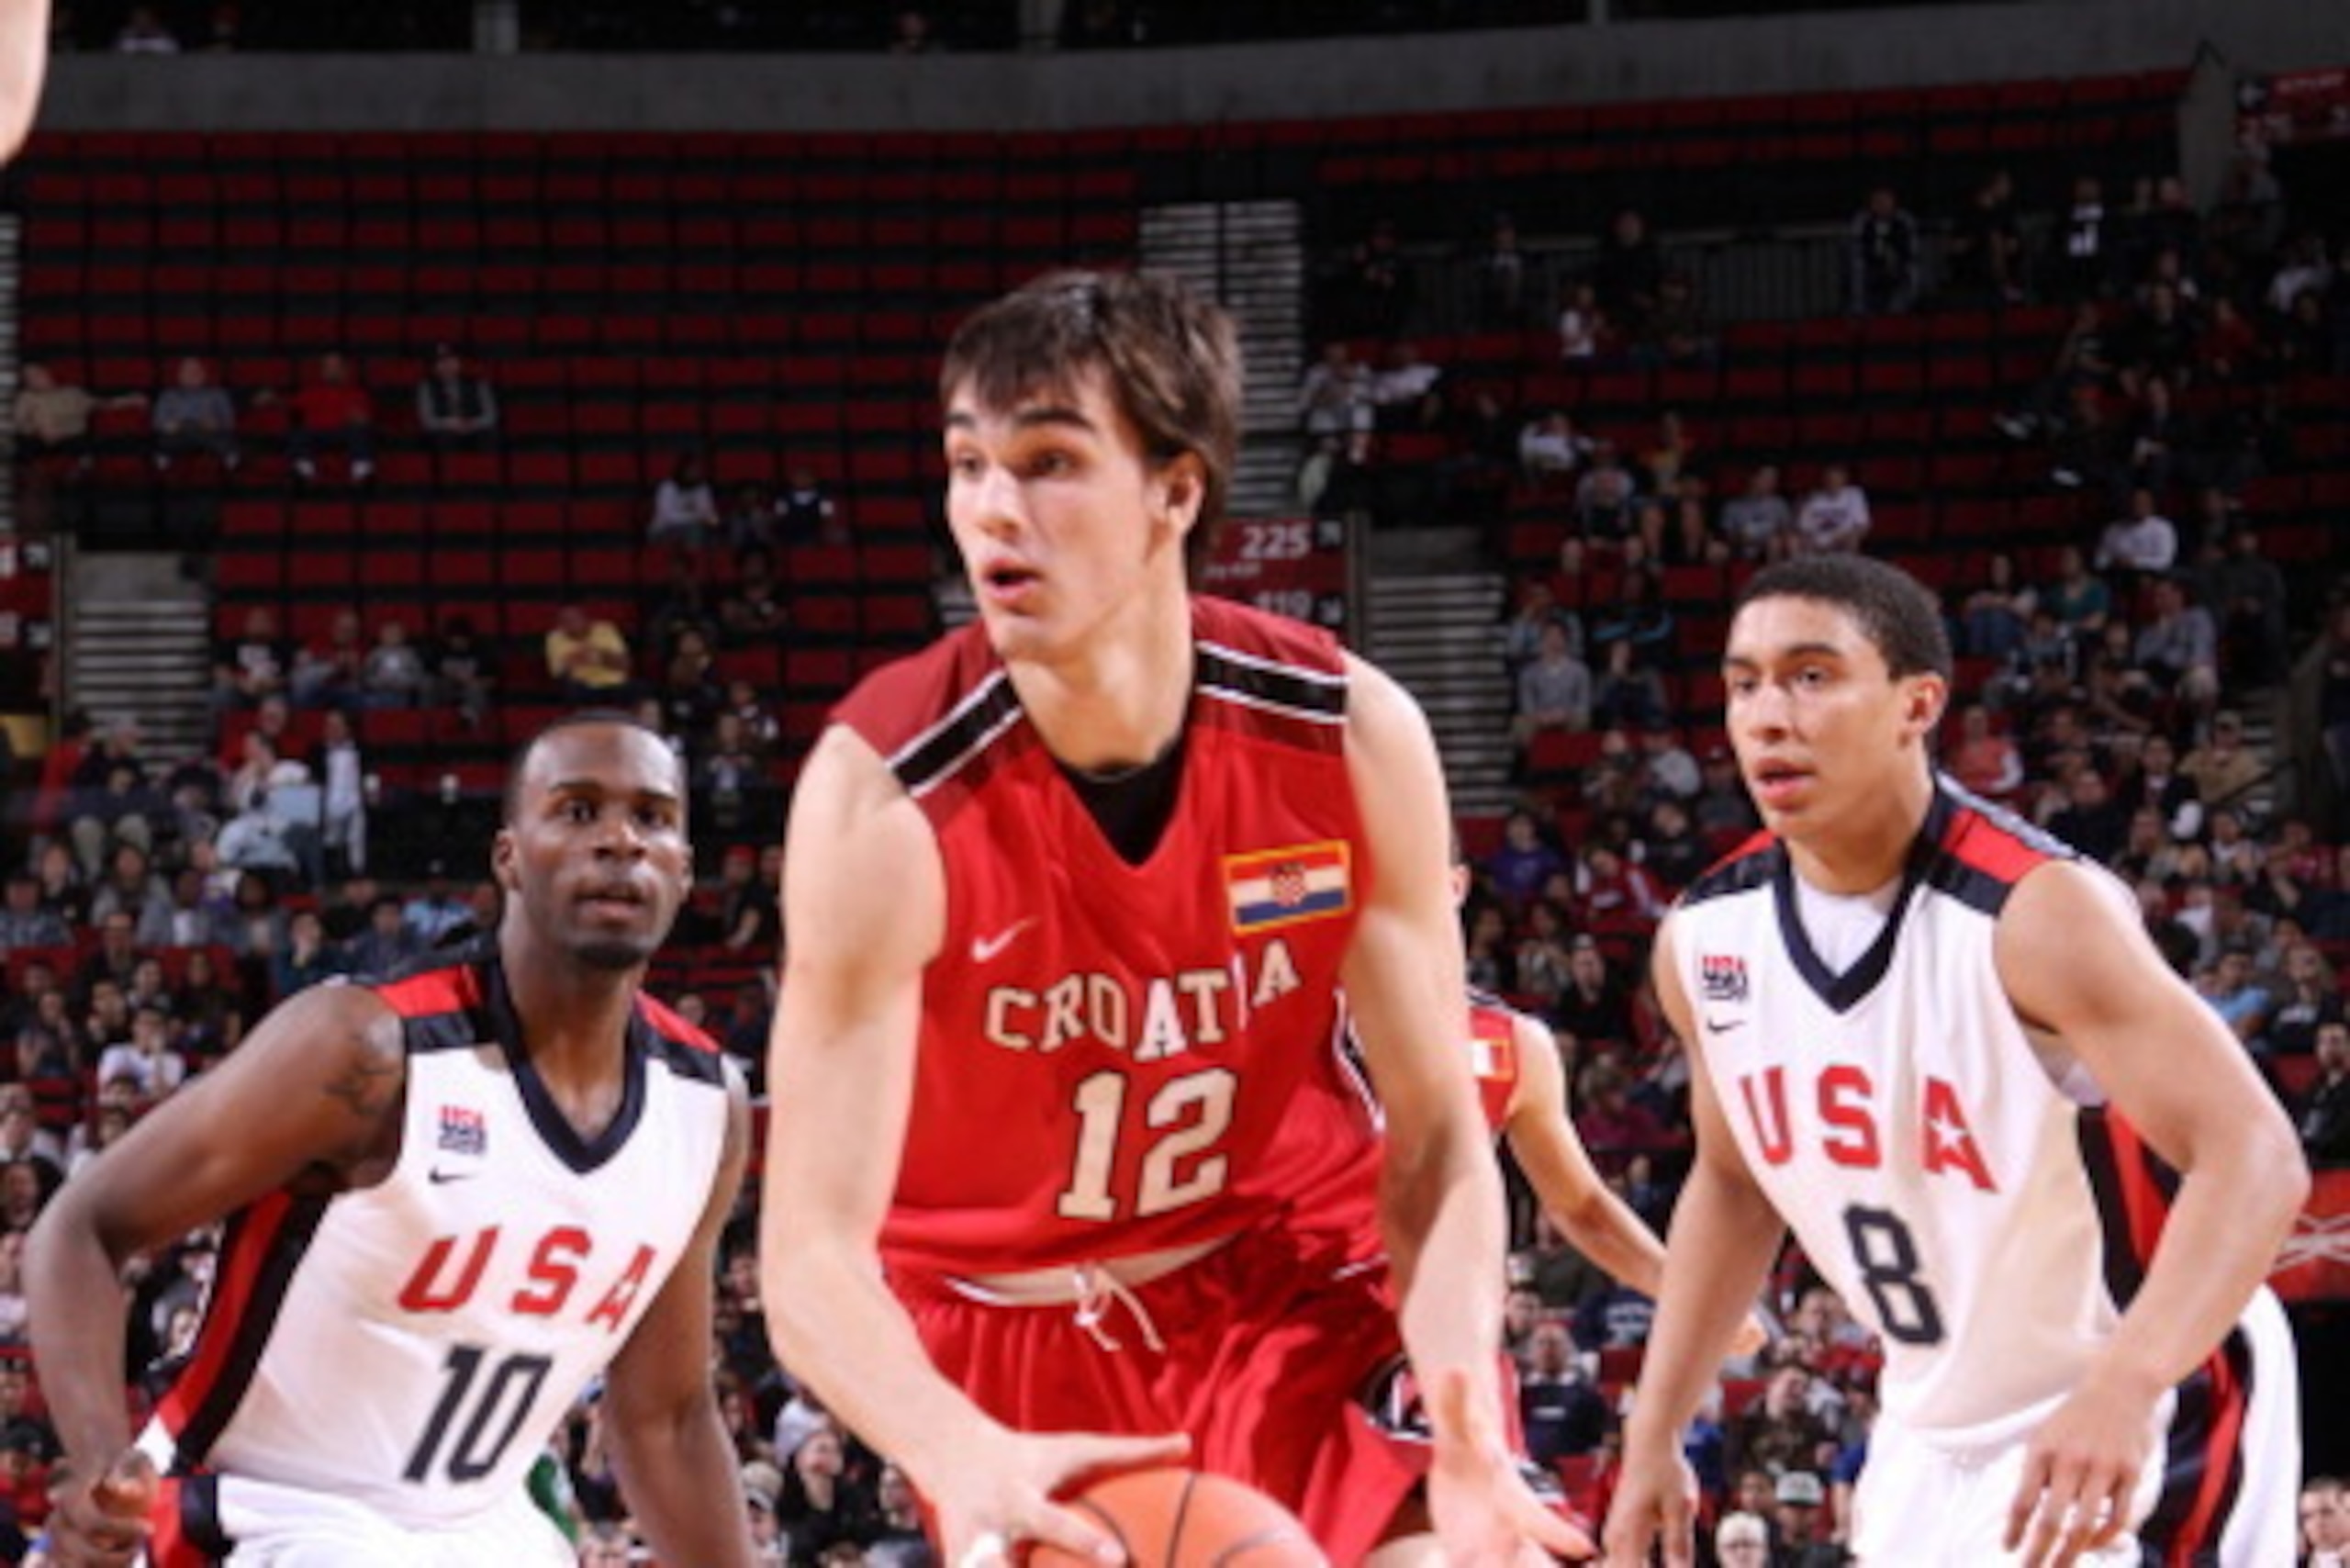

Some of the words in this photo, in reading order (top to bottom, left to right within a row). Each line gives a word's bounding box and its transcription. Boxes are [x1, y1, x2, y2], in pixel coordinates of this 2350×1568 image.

[1240, 522, 1312, 560] 225
[1058, 1067, 1237, 1221] 12
[1739, 1064, 1998, 1193] USA
[397, 1223, 657, 1333] USA
[1842, 1204, 1945, 1346] 8
[401, 1343, 554, 1485] 10
